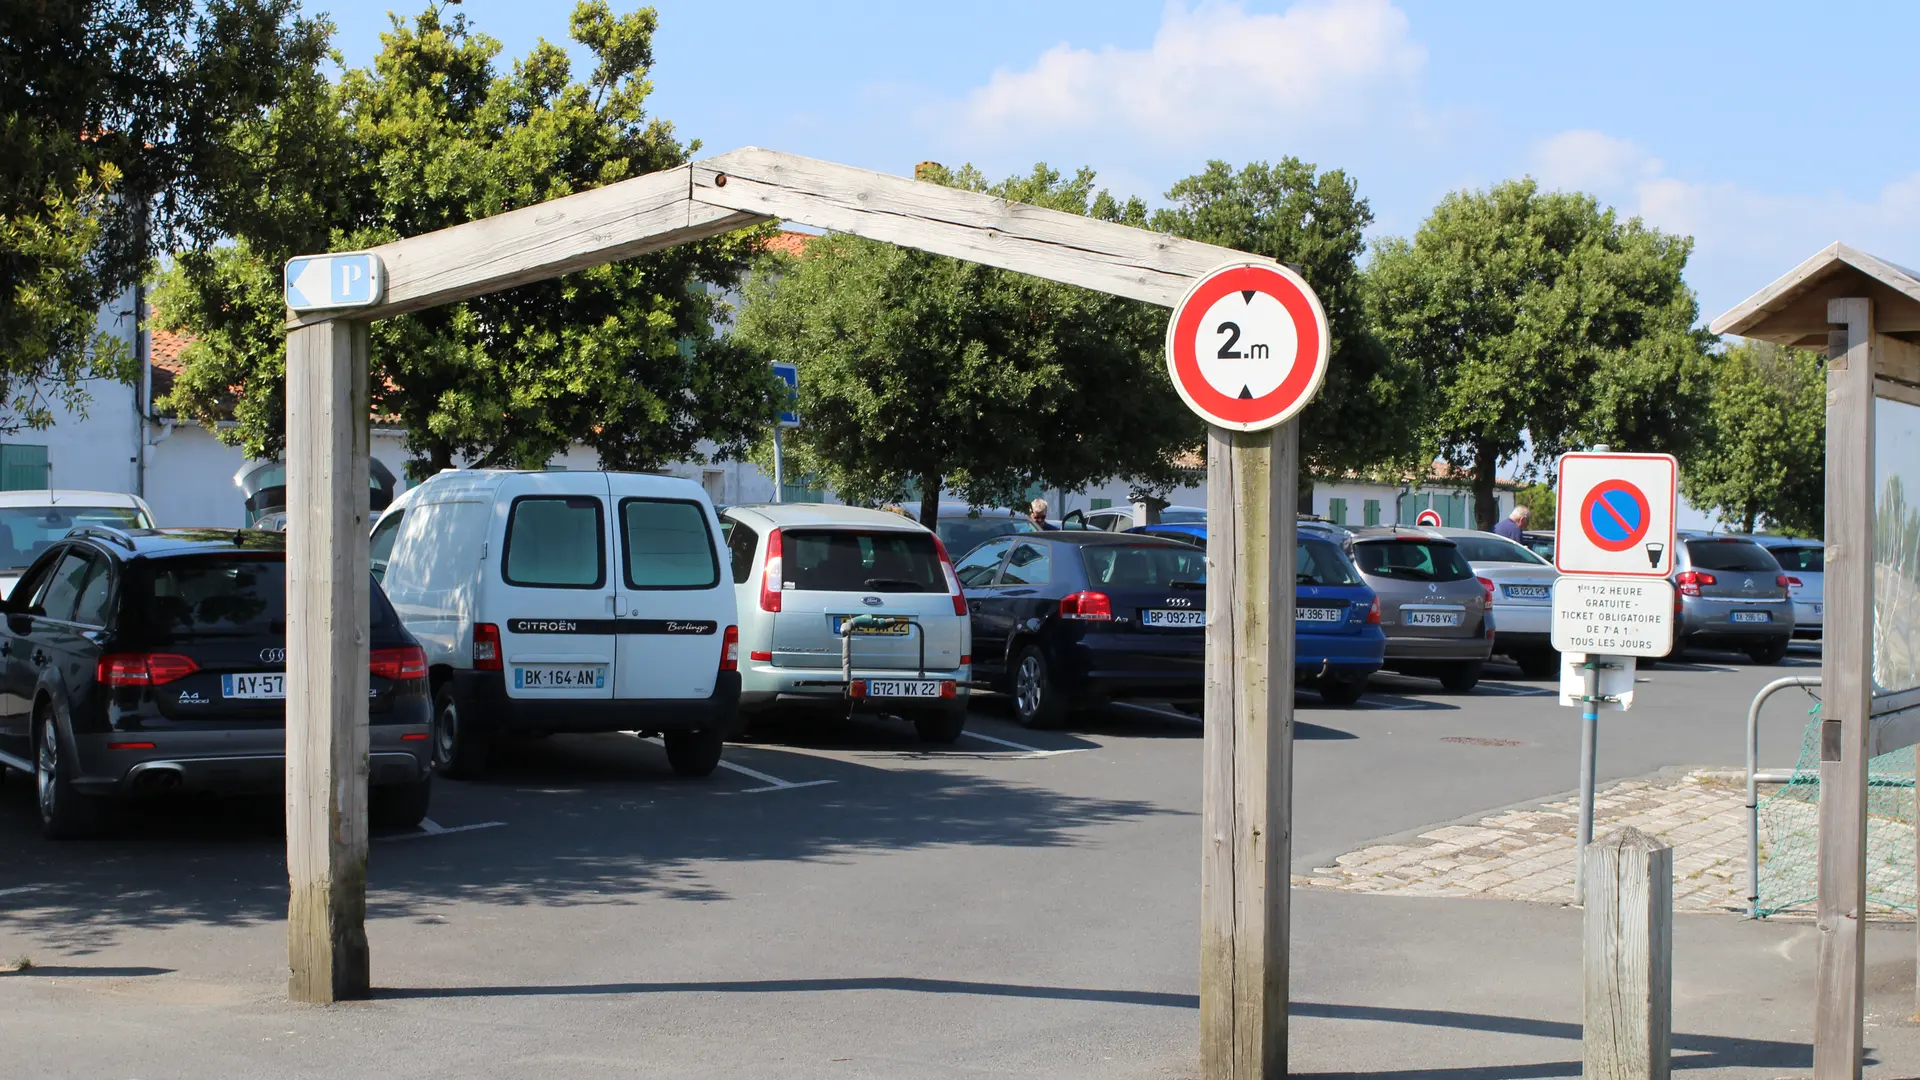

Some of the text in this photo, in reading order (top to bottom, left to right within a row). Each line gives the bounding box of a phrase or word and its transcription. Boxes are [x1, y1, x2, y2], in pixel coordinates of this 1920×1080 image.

[341, 264, 362, 296] P
[1592, 586, 1605, 595] 1/2
[1609, 587, 1643, 596] HEURE
[1585, 599, 1631, 609] GRATUITE
[1150, 611, 1202, 624] BP-092-PZ
[1413, 613, 1452, 624] AJ-768-VX
[1561, 611, 1661, 623] TICKET OBLIGATOIRE
[517, 620, 577, 631] CITROËN
[666, 621, 709, 633] Berlingo
[1586, 625, 1599, 634] DE
[1570, 637, 1652, 649] TOUS LES JOURS
[525, 670, 594, 685] BK-164-AN
[237, 676, 284, 694] AY-57
[873, 681, 936, 696] 6721 WX 22
[179, 690, 199, 699] A4
